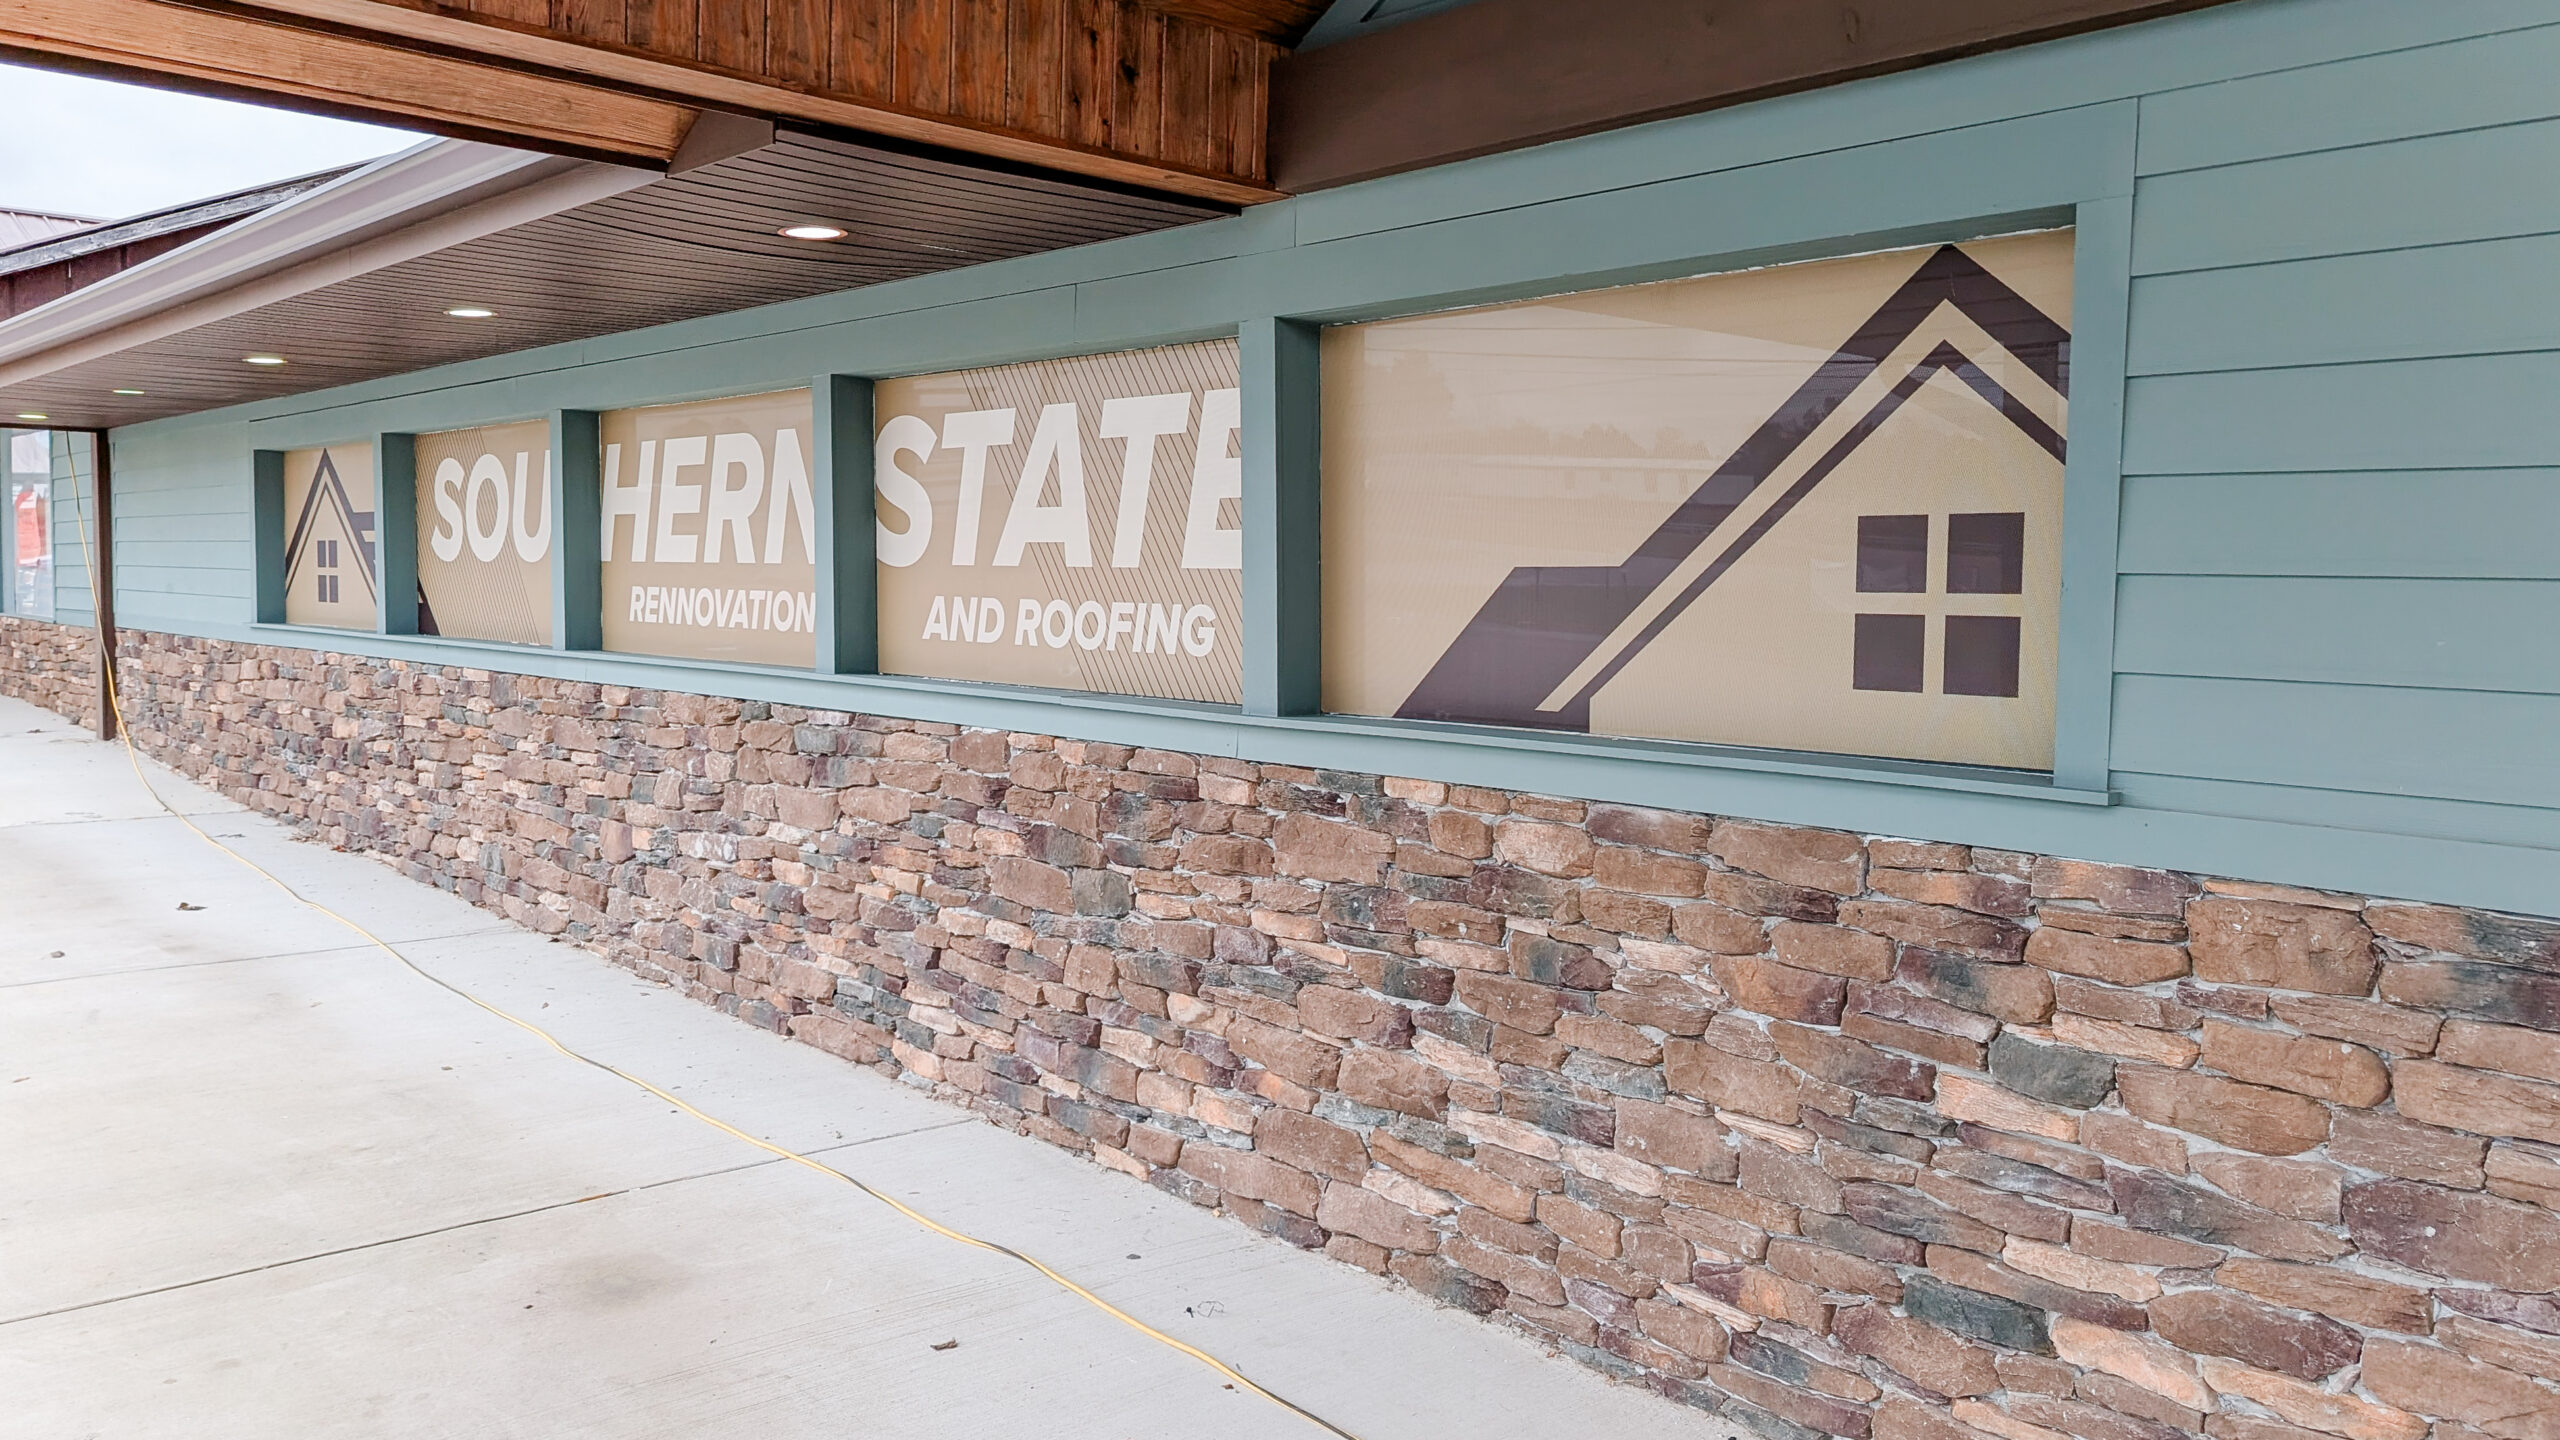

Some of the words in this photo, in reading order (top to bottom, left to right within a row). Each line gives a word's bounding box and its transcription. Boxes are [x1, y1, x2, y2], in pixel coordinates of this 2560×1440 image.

[430, 428, 815, 564] SOUHERN
[629, 585, 816, 633] RENNOVATION
[922, 595, 1004, 642] AND
[1015, 599, 1216, 657] ROOFING
